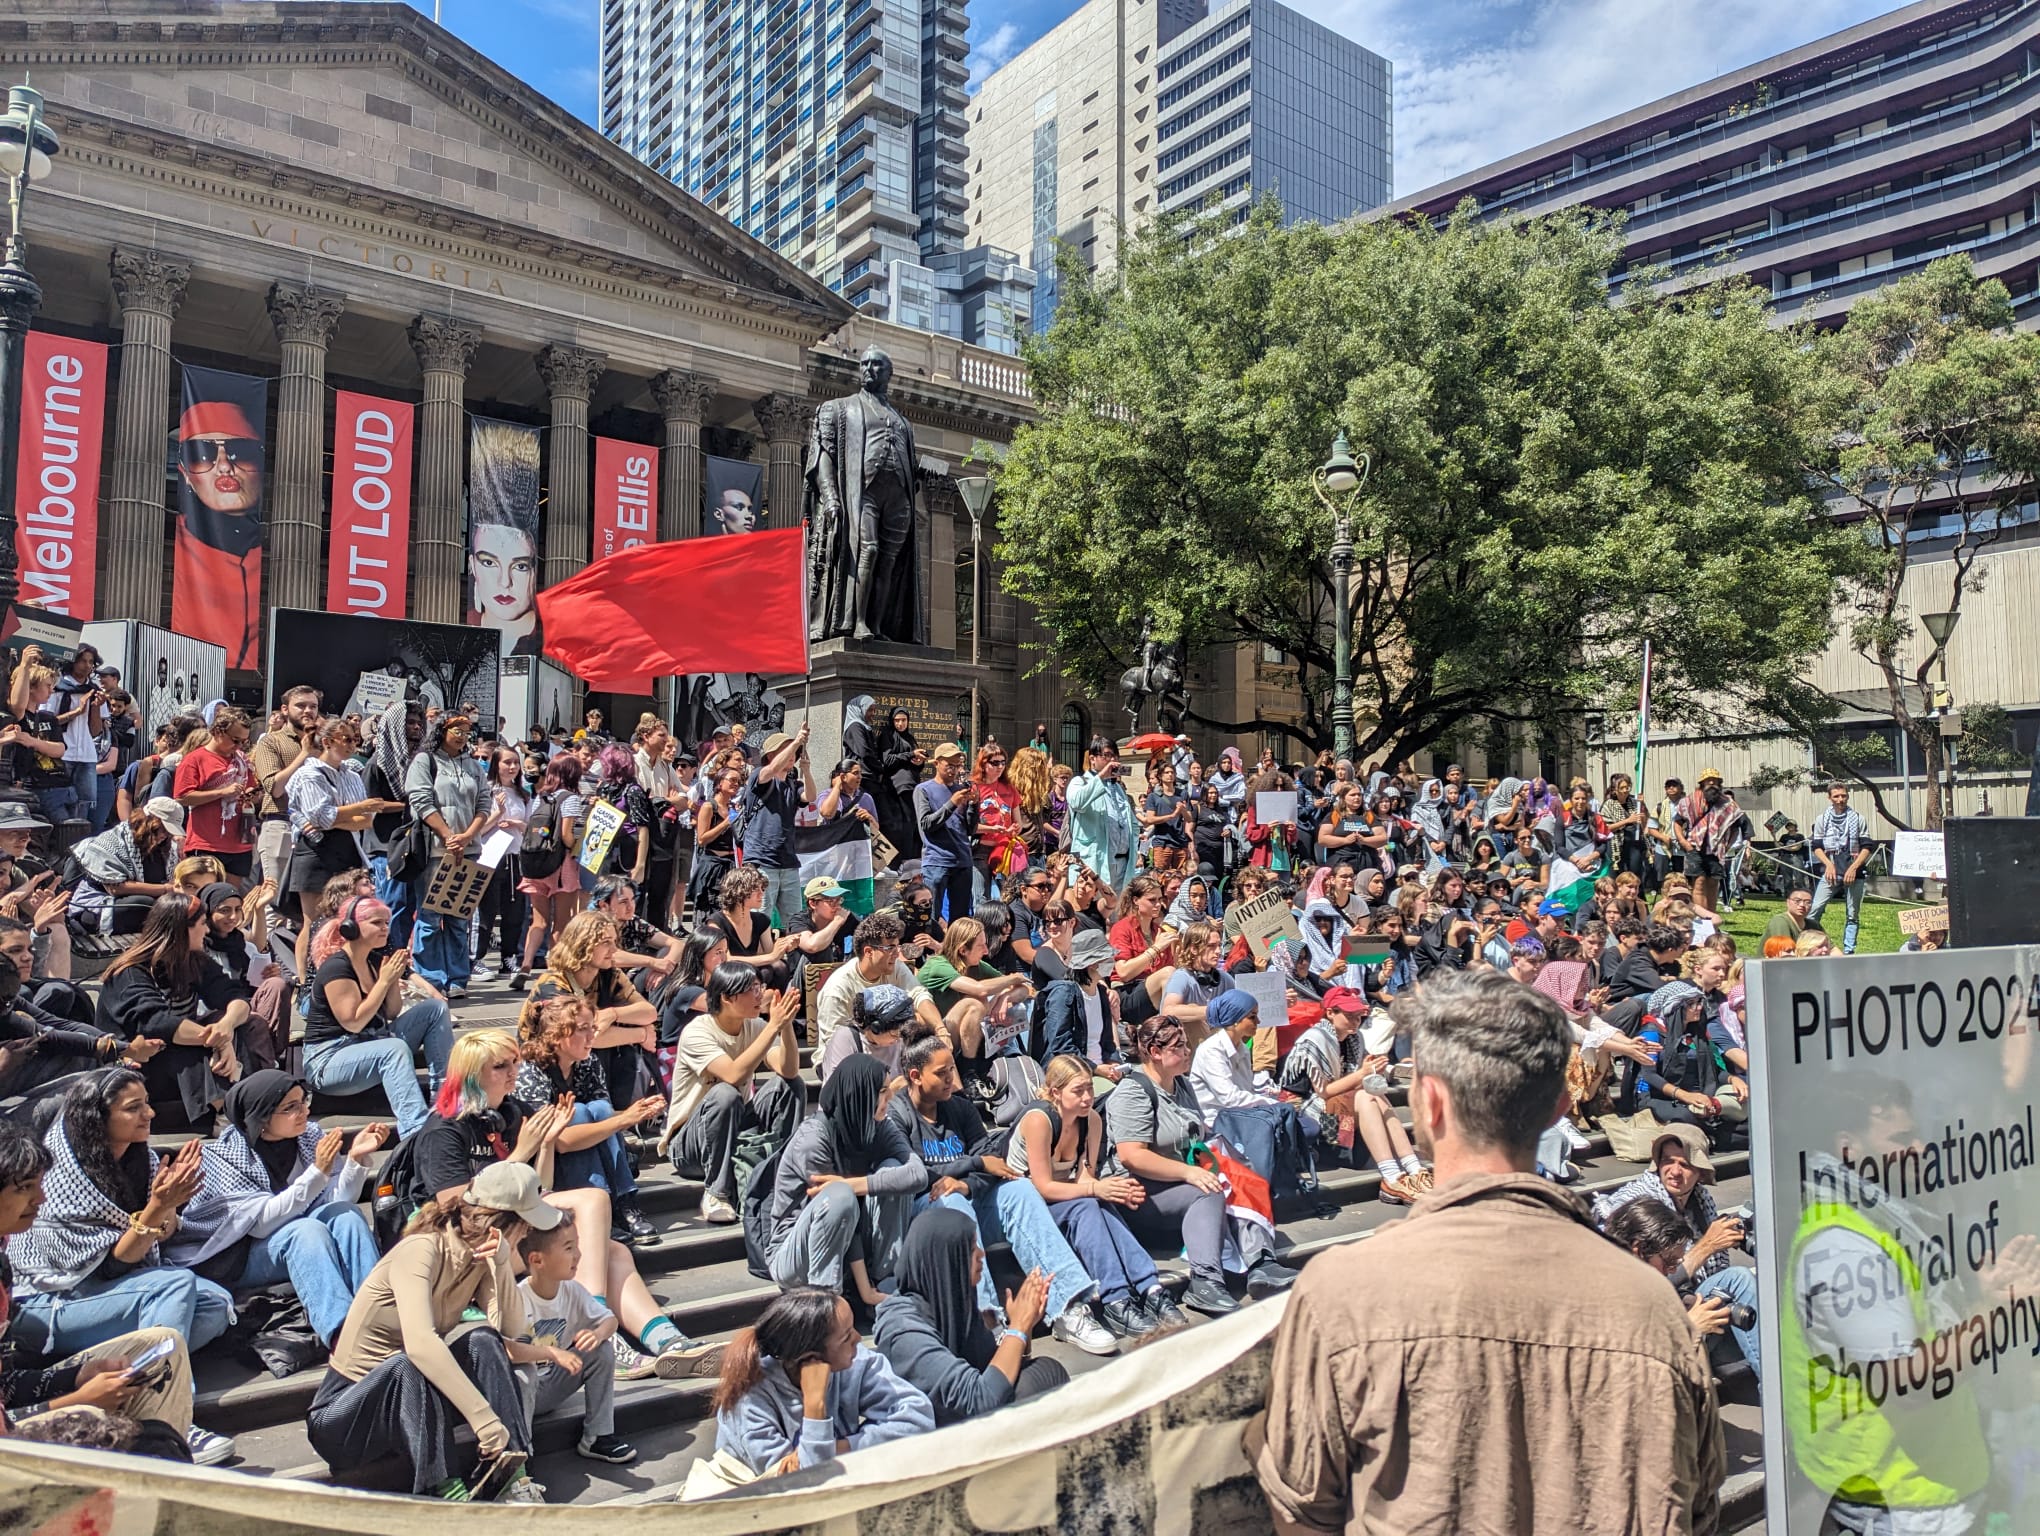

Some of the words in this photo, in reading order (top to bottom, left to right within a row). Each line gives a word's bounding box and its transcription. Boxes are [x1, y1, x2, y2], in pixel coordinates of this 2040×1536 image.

[252, 219, 505, 297] VICTORIA
[24, 354, 83, 615] Melbourne
[351, 410, 394, 538] LOUD
[617, 456, 650, 531] Ellis
[347, 545, 389, 617] UT
[425, 863, 453, 905] FREE
[440, 865, 468, 910] PALE-
[459, 870, 489, 916] STINE
[1235, 886, 1284, 924] INTIFADA
[1903, 909, 1923, 922] SHUT
[1923, 909, 1930, 919] IT
[1903, 919, 1949, 933] PALESTINE
[1791, 981, 1947, 1065] PHOTO
[1955, 973, 2040, 1043] 2024
[1799, 1104, 2035, 1224] International
[1804, 1212, 1957, 1329] Festival
[1967, 1199, 1999, 1272] of
[1808, 1284, 2040, 1434] Photography
